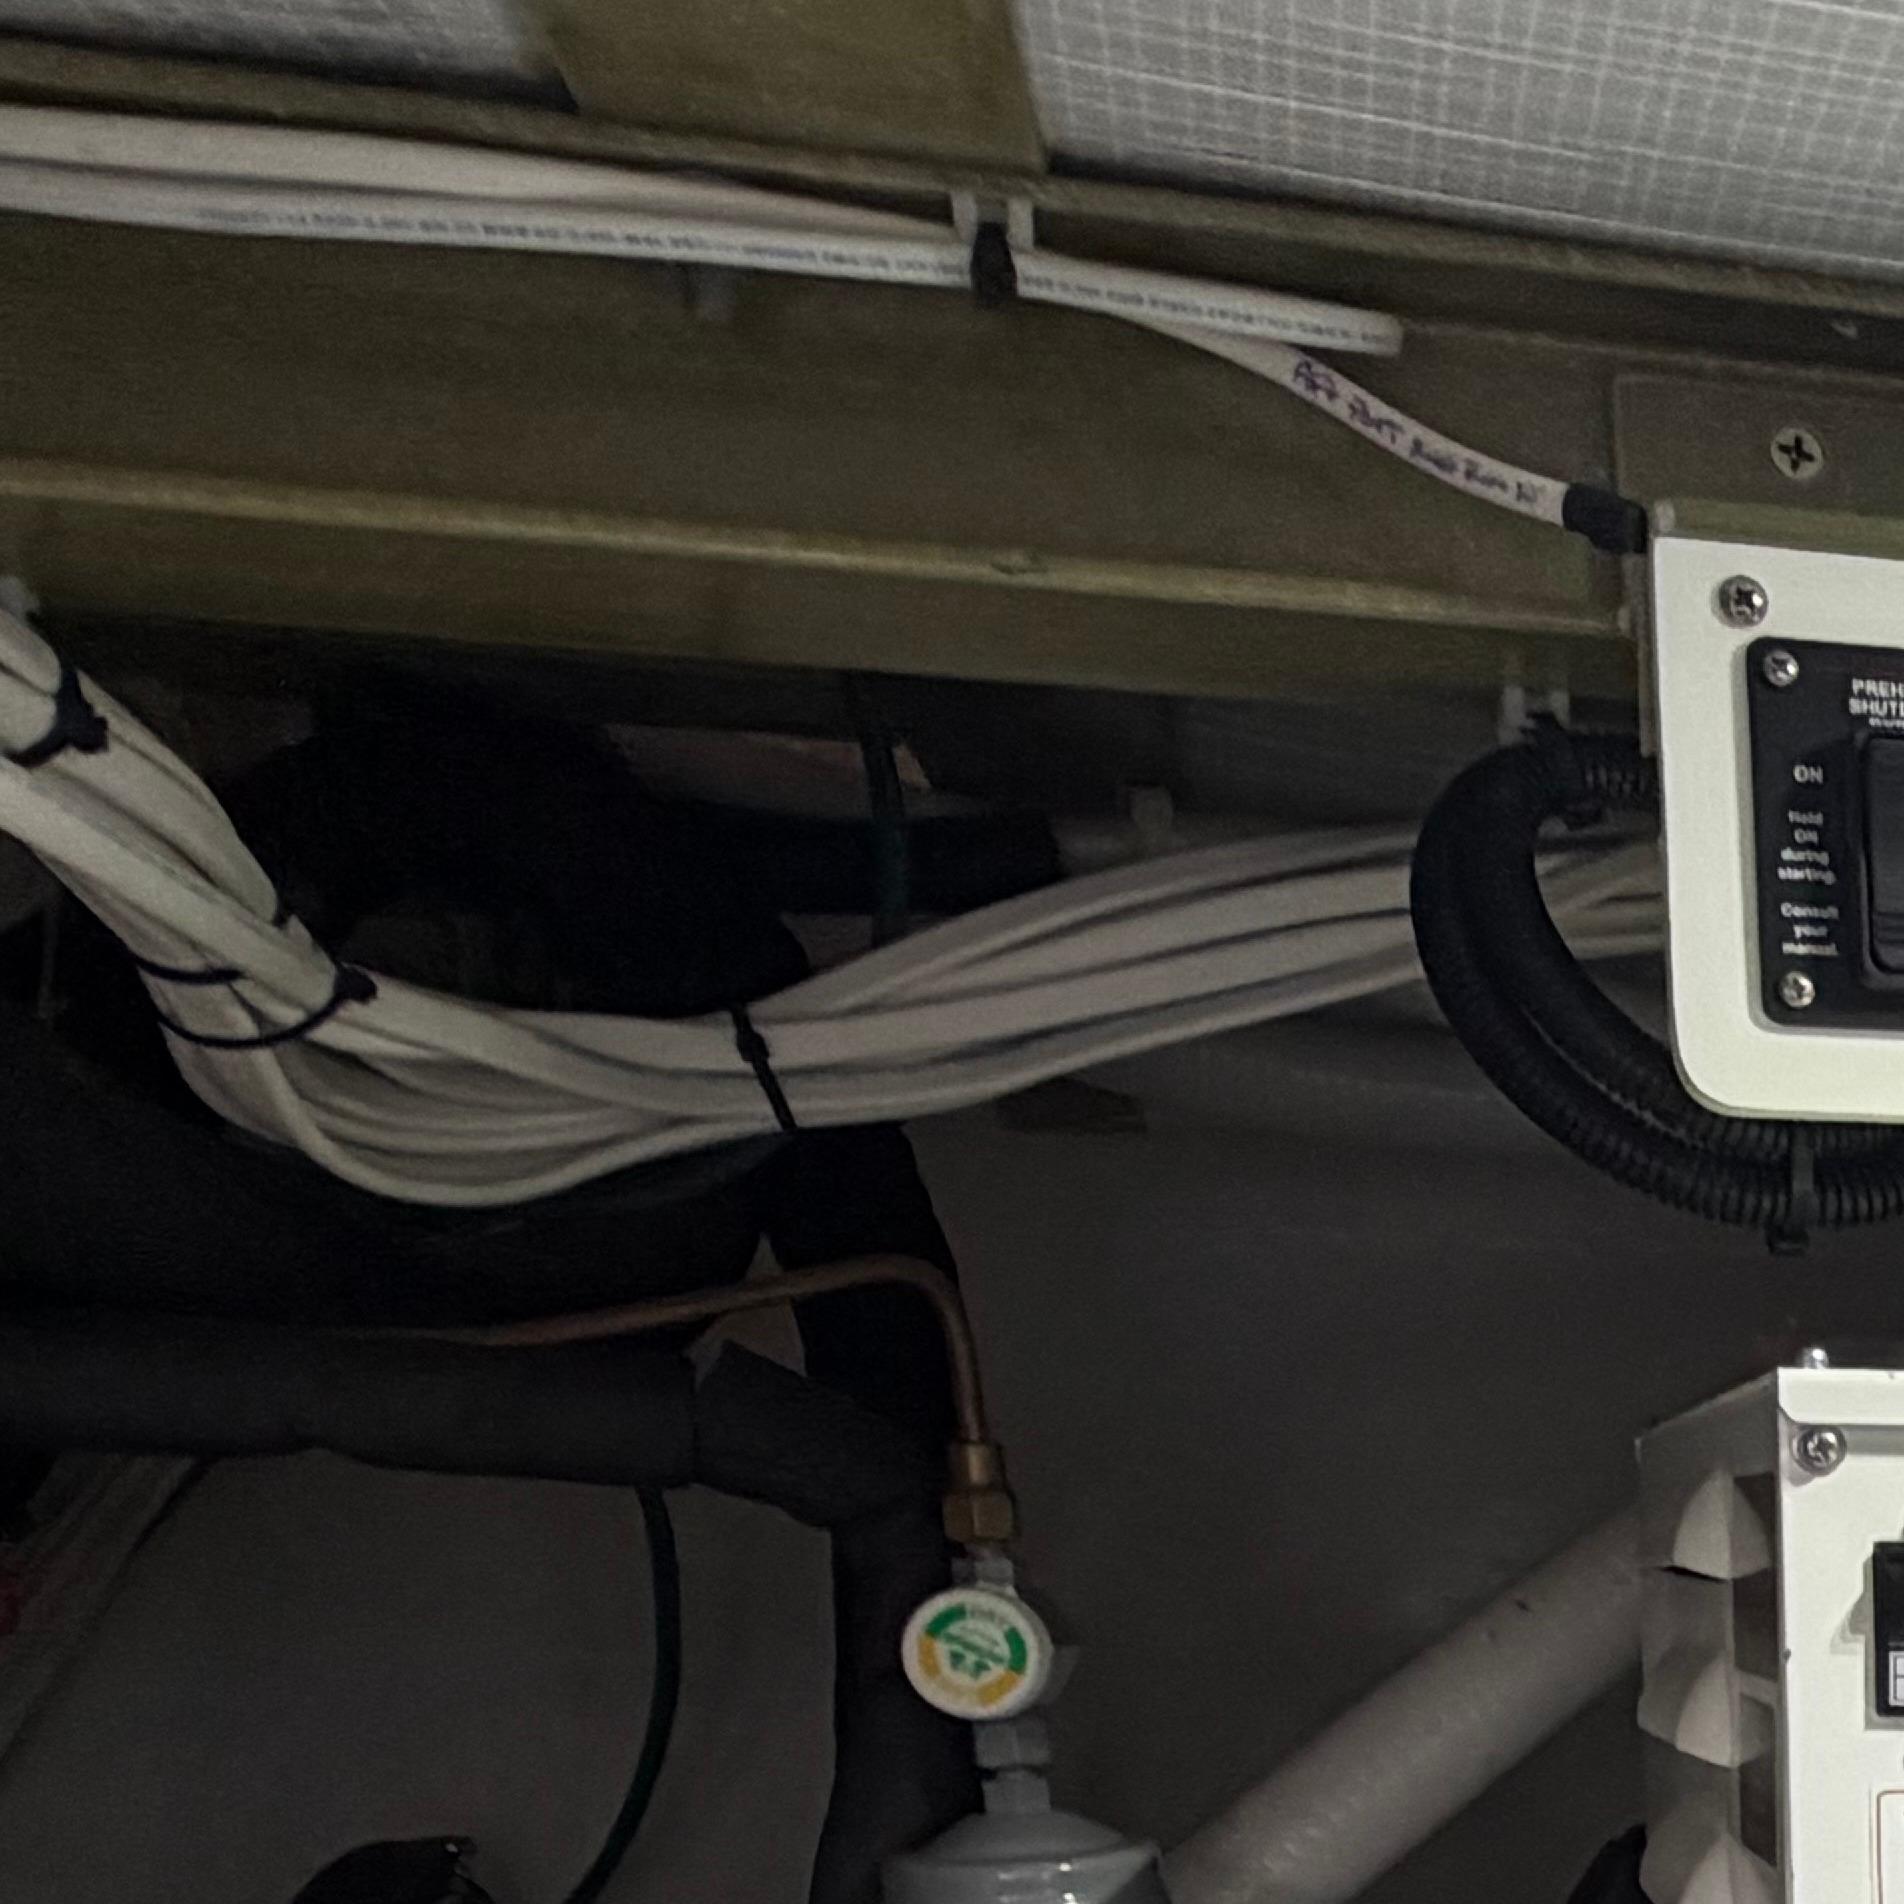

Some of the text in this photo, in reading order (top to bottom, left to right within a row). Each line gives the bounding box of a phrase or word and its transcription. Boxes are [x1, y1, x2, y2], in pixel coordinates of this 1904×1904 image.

[1793, 764, 1825, 785] ON
[1780, 902, 1840, 920] Consult
[1792, 923, 1829, 939] your
